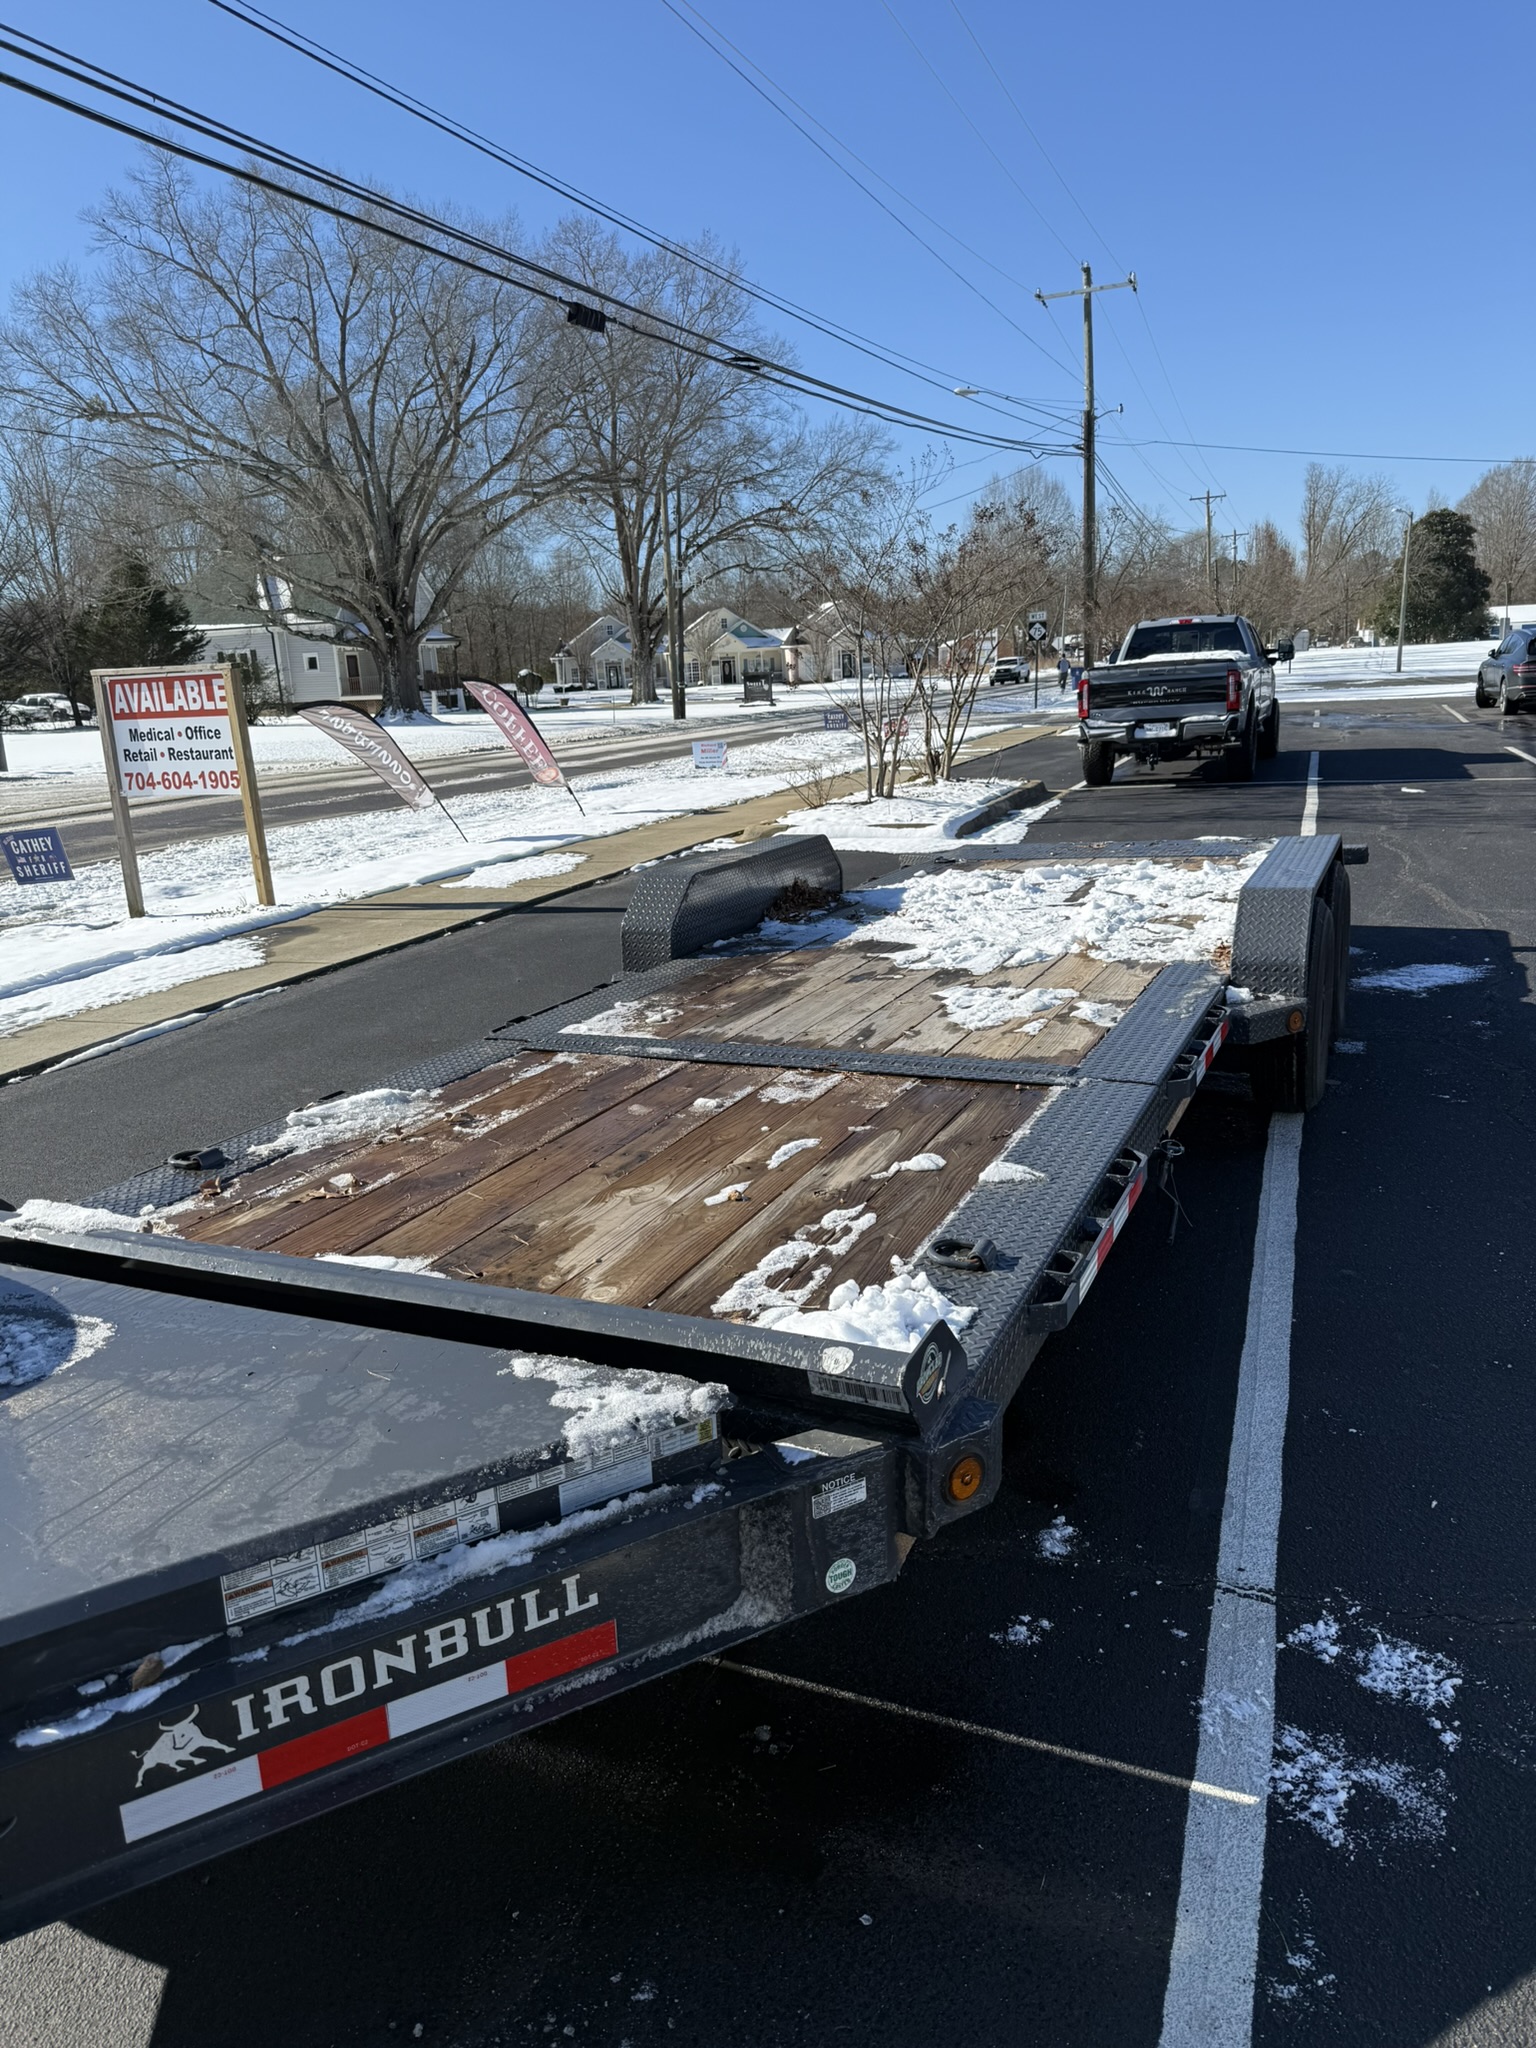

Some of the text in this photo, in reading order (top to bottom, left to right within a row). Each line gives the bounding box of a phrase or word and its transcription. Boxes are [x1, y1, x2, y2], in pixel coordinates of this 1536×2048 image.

[1033, 627, 1043, 636] 75
[114, 679, 228, 714] AVAILABLE
[128, 726, 222, 742] Medical Office
[482, 689, 548, 768] COFFEE
[123, 746, 235, 763] Retail Restaurant
[124, 770, 241, 791] 704-604-1905
[10, 836, 53, 854] CATHEY
[16, 861, 66, 878] SHERIFF
[821, 1472, 856, 1491] NOTICE
[420, 1520, 454, 1536] WARNING
[328, 1550, 364, 1566] WARNING
[829, 1569, 852, 1583] TOUGH
[234, 1582, 270, 1598] WARNING
[232, 1573, 599, 1741] IRONBULL
